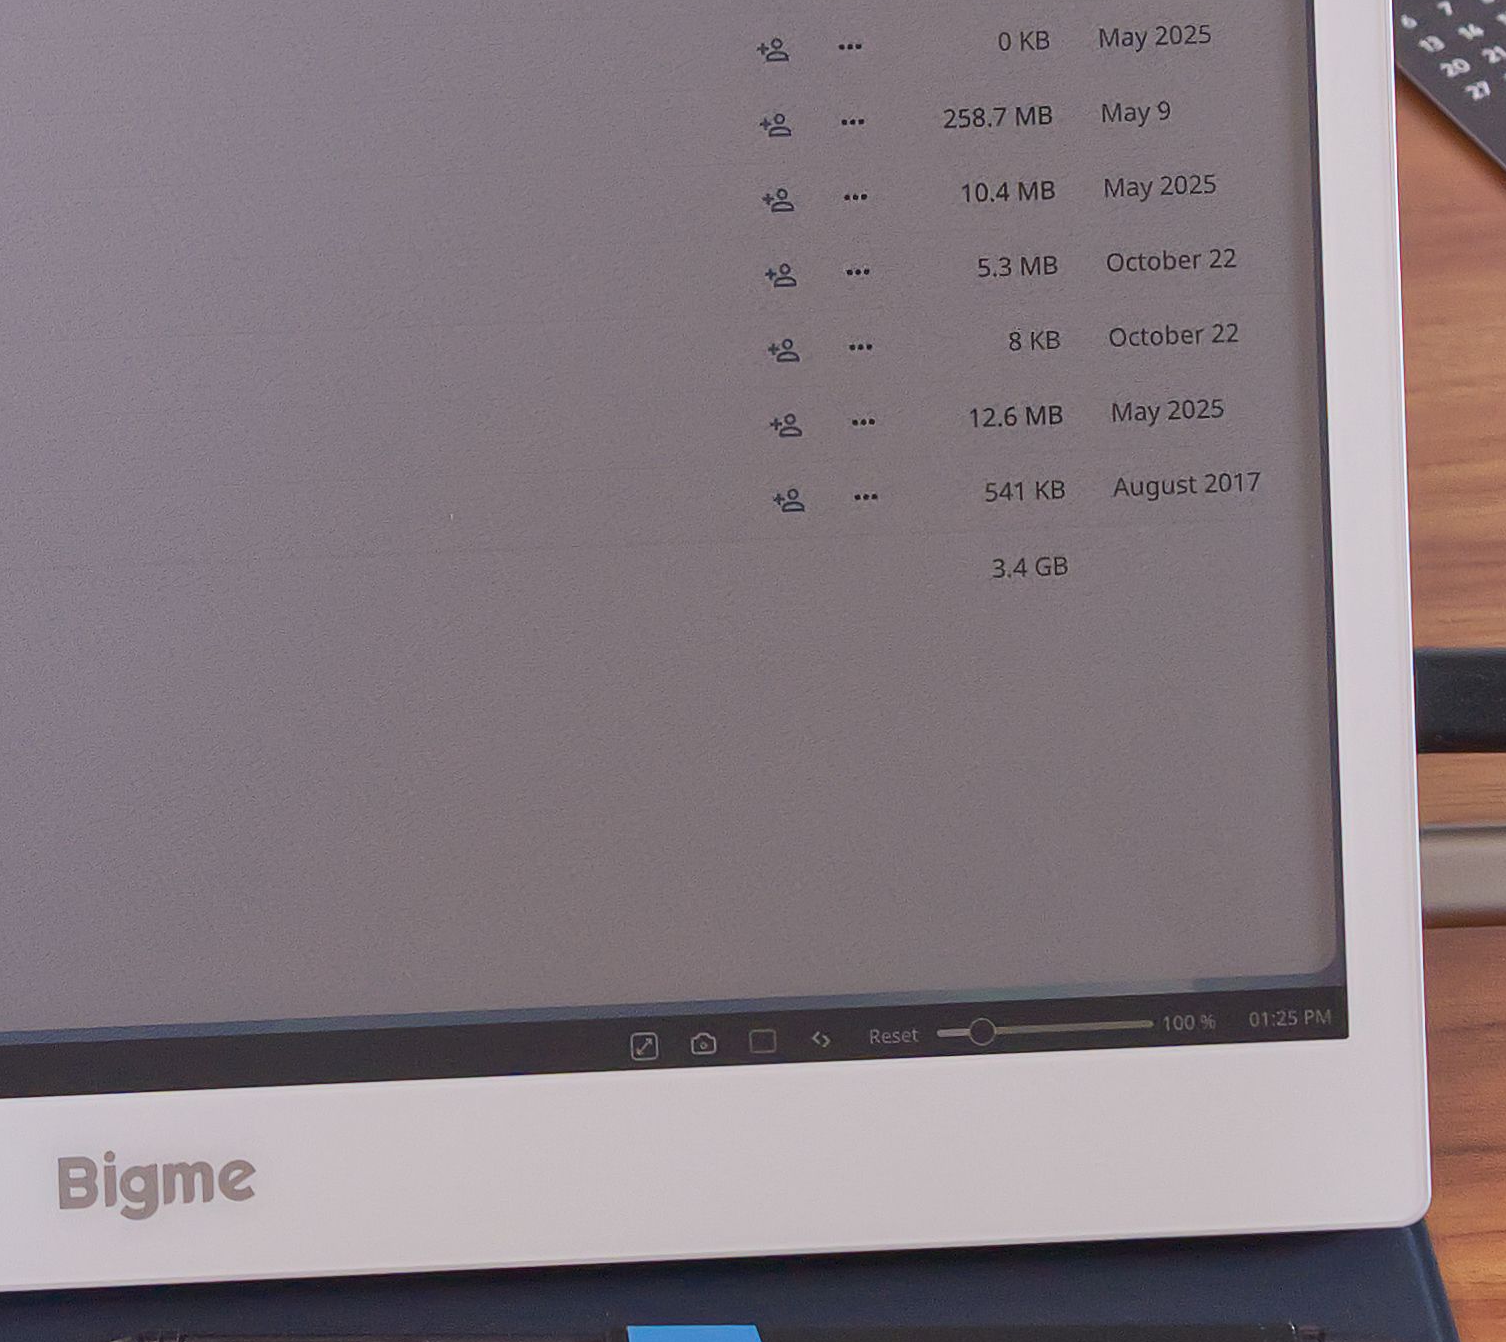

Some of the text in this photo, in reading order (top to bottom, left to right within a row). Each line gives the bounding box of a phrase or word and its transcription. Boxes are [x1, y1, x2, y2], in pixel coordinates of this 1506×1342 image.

[943, 105, 1053, 129] 258.7 MB
[1101, 100, 1171, 128] May 9
[978, 255, 1058, 278] 5.3 MB
[1106, 247, 1237, 273] October 22
[1008, 330, 1061, 352] 8 KB
[1108, 322, 1239, 348] October 22
[969, 405, 1063, 428] 12.6 MB
[1111, 398, 1225, 428] May 2025
[985, 479, 1066, 503] 541 KB
[1113, 471, 1261, 502] August 2017
[992, 555, 1069, 579] 3.4 GB
[1163, 1014, 1196, 1032] 100
[1248, 1008, 1332, 1028] 01:25 PM
[869, 1028, 919, 1045] Reset
[58, 1150, 256, 1220] Bigme
